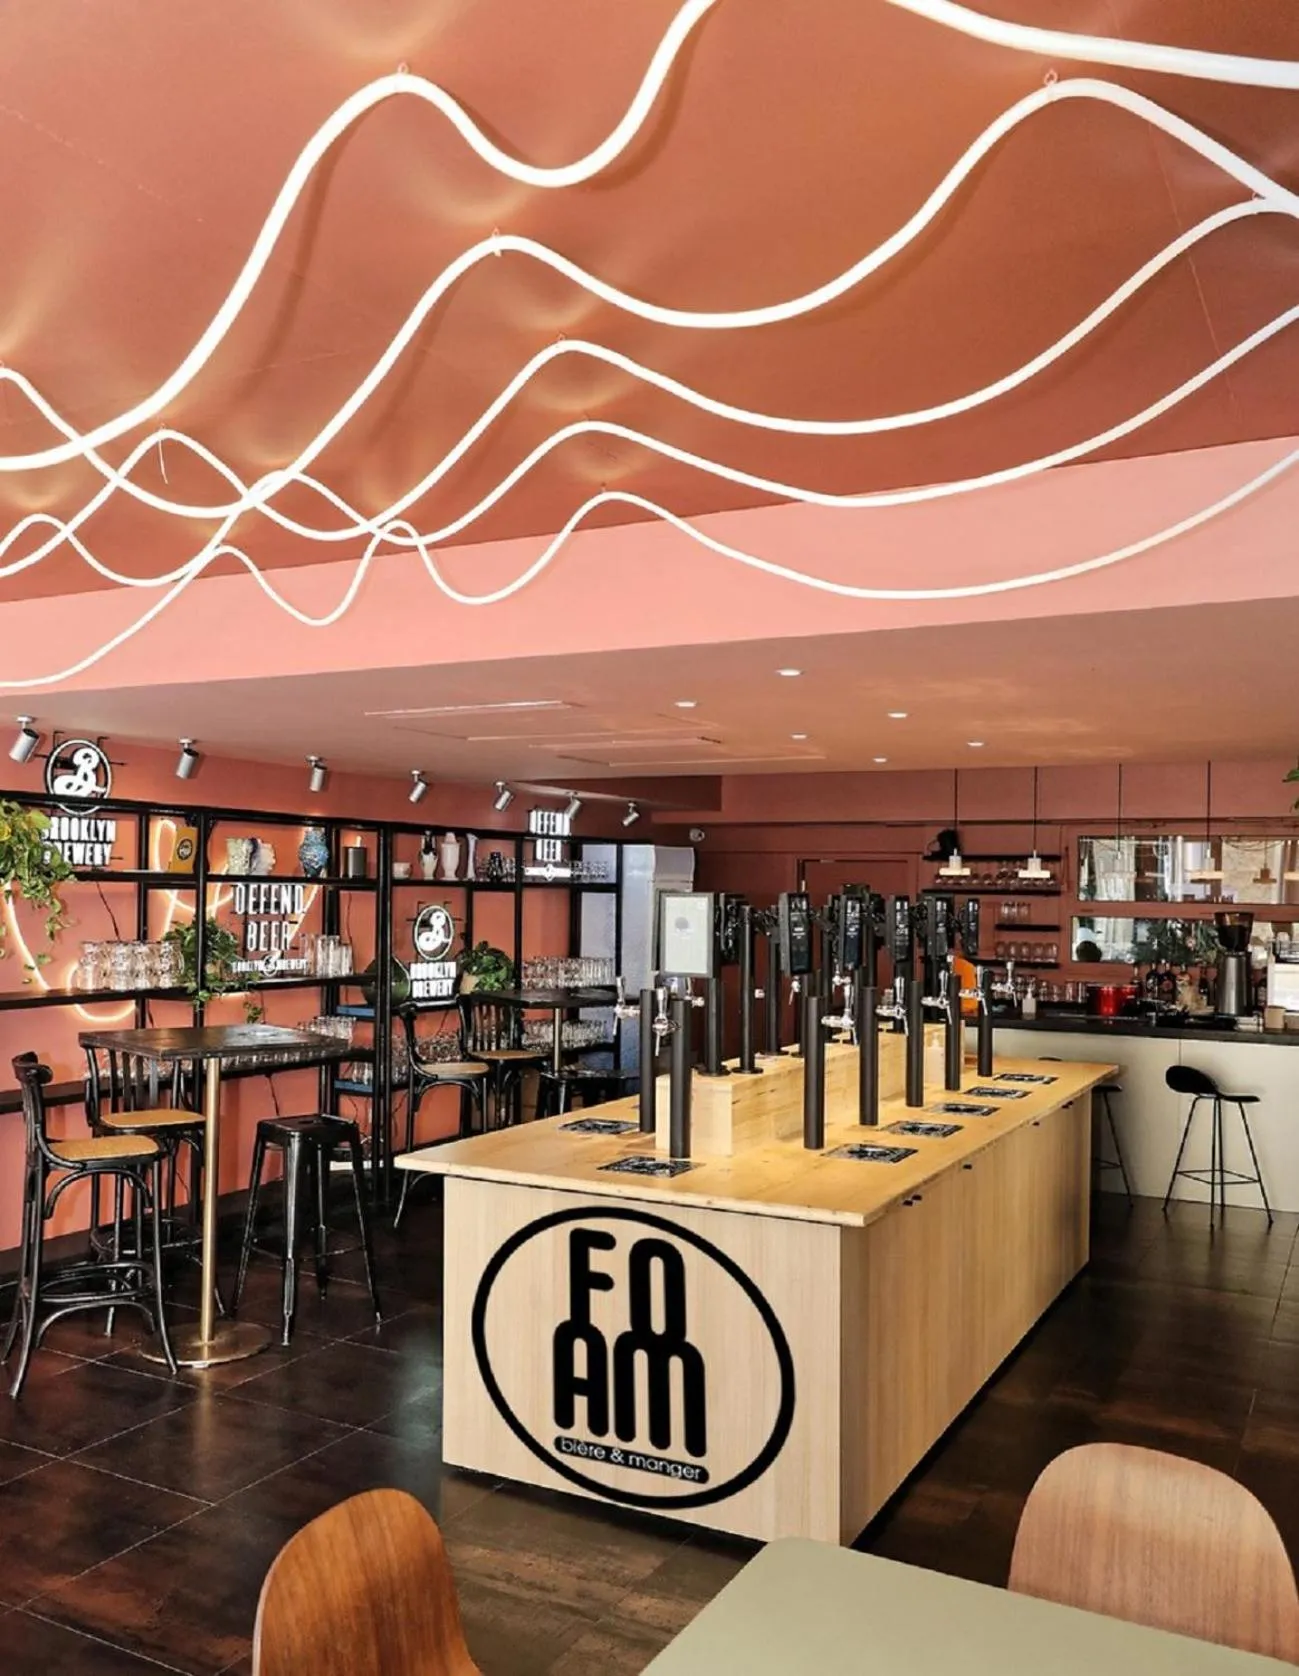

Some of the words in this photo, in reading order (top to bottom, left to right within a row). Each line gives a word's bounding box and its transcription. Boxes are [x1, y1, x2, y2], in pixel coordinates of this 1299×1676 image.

[235, 882, 304, 915] DEFEND
[247, 920, 291, 952] BEER
[610, 1447, 625, 1464] &
[628, 1454, 701, 1480] manger
